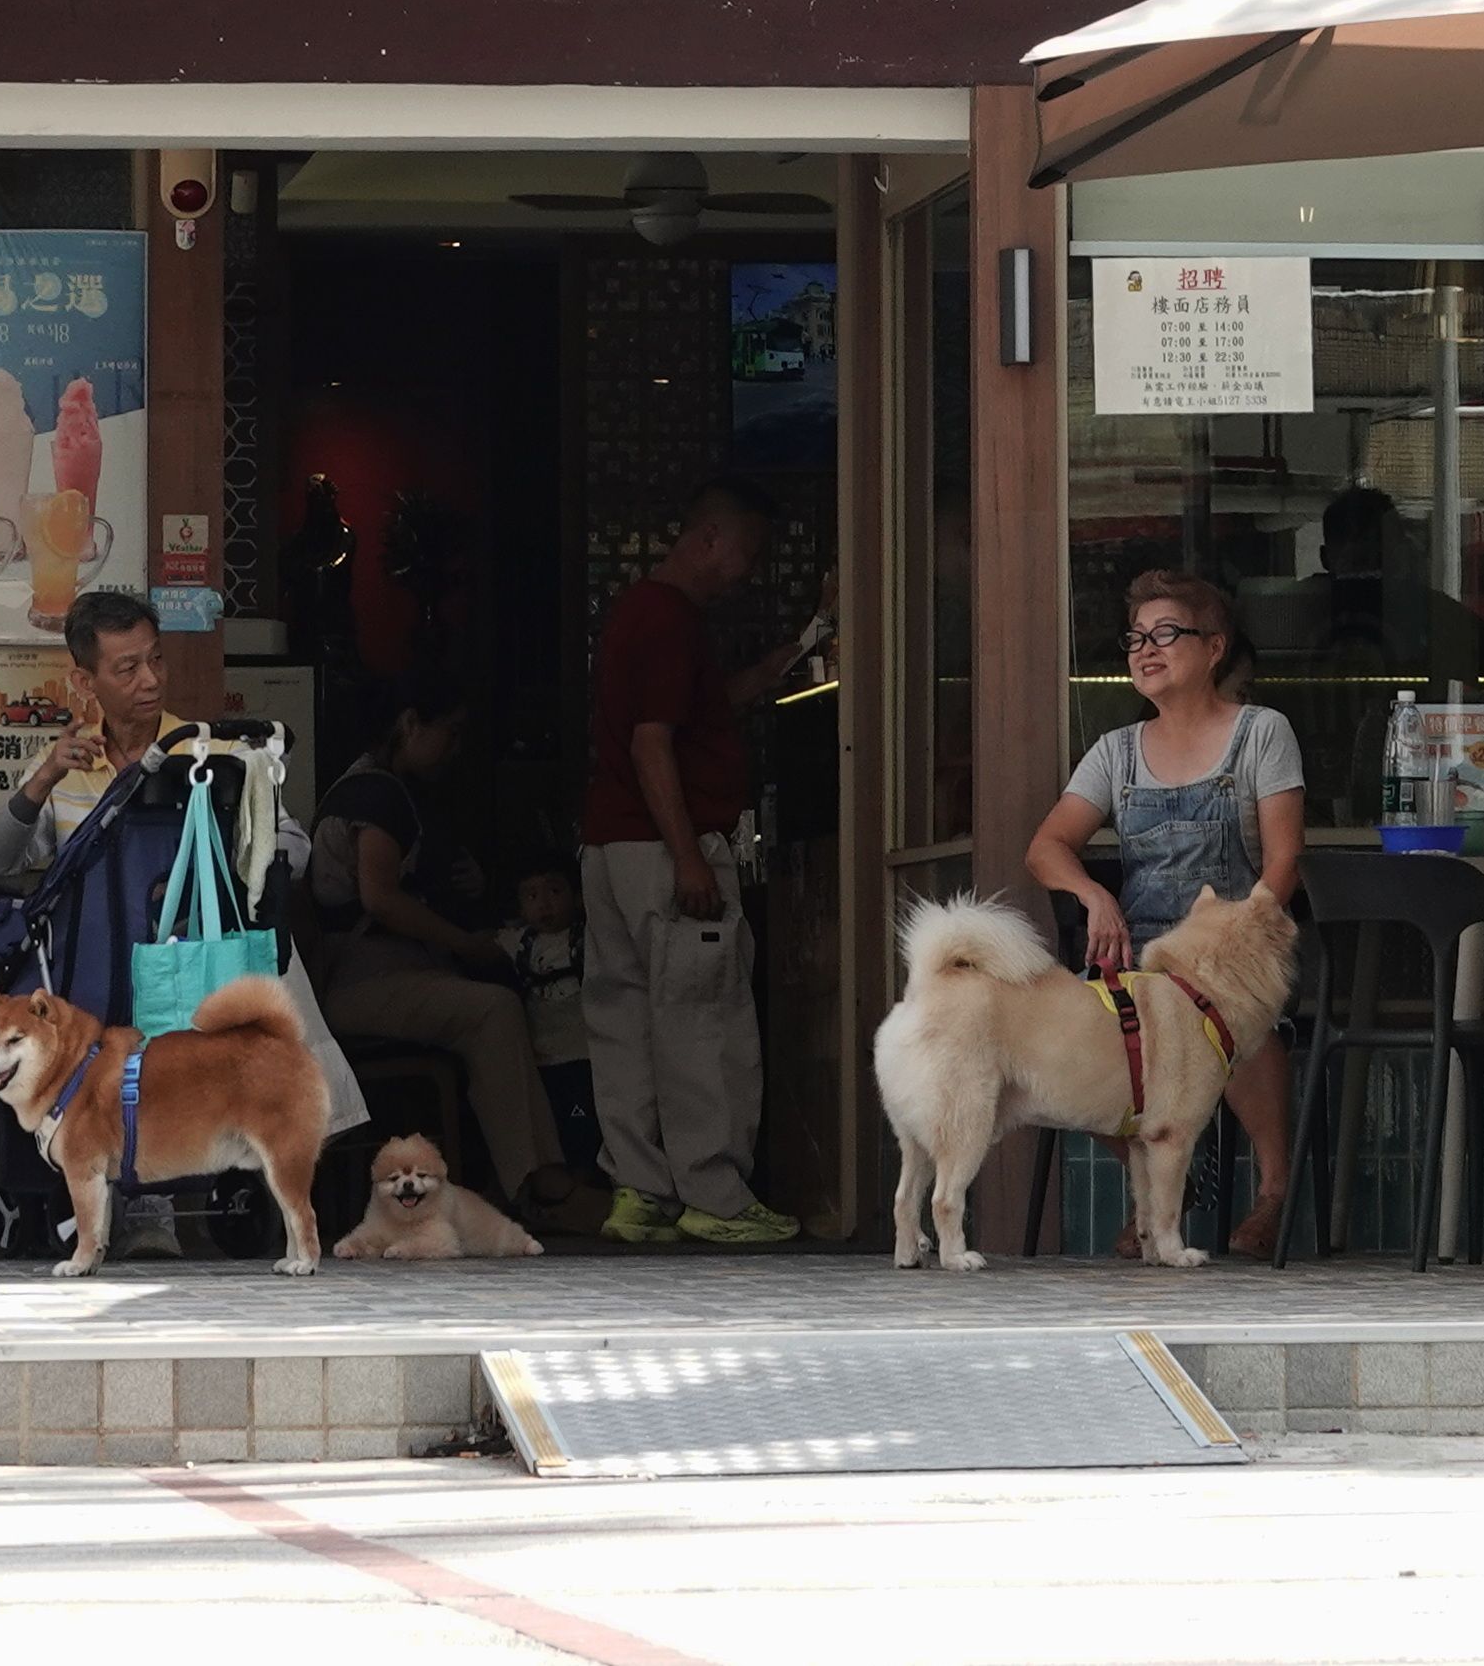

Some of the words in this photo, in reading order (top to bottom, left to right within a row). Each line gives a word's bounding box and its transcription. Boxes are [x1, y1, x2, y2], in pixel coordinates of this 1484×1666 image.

[1178, 266, 1226, 289] 招聘
[1151, 294, 1250, 315] 樓面店務員
[1160, 321, 1191, 332] 07:00
[1214, 321, 1245, 332] 14:00
[1161, 337, 1192, 348] 07:00
[1214, 337, 1245, 348] 17:00
[1162, 352, 1193, 363] 12:30
[1214, 352, 1245, 363] 22:30
